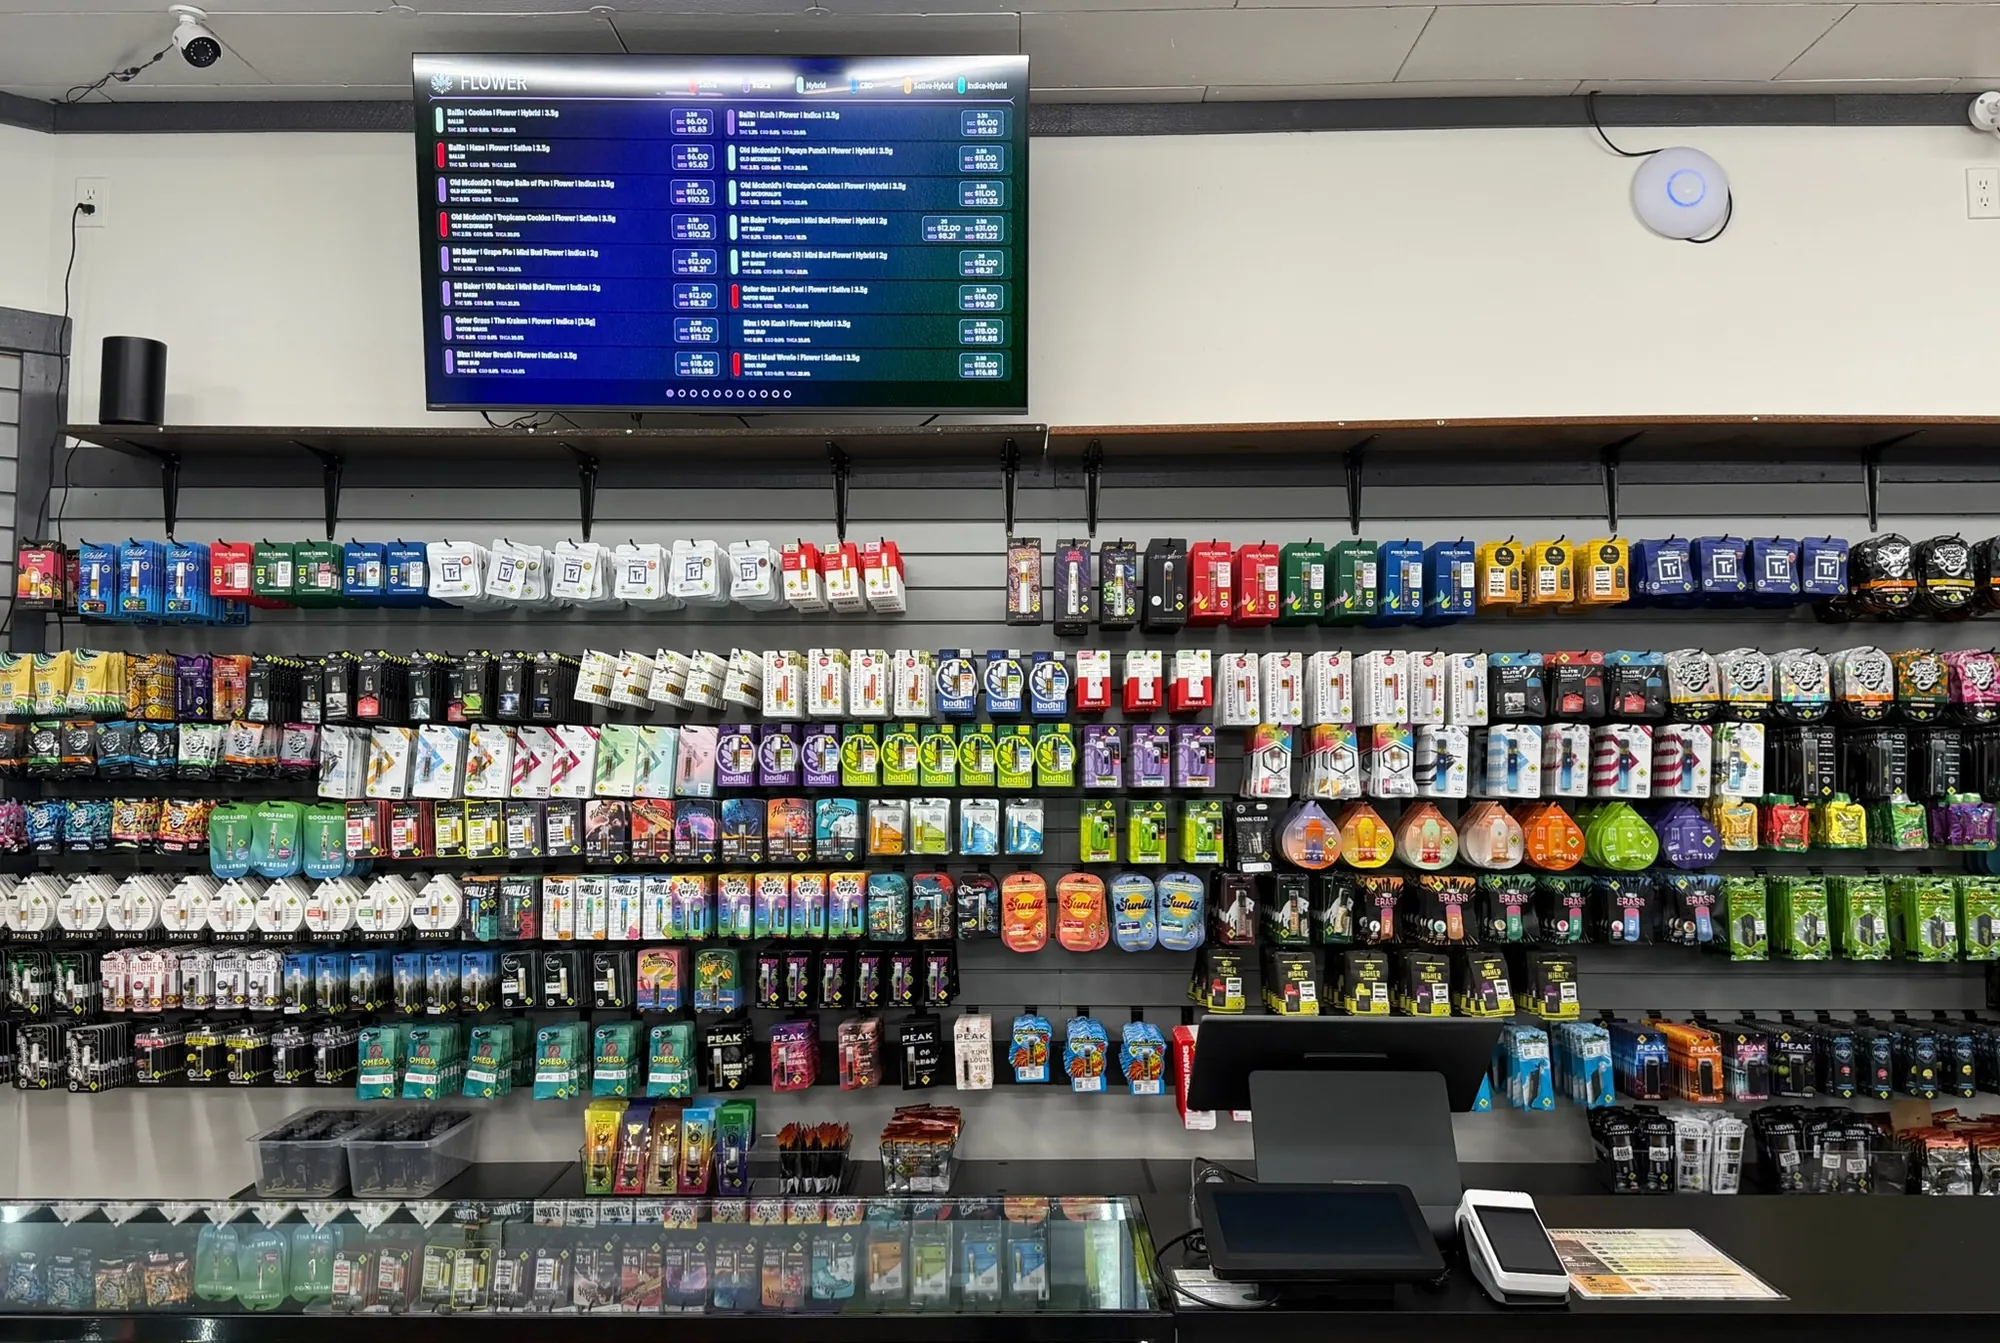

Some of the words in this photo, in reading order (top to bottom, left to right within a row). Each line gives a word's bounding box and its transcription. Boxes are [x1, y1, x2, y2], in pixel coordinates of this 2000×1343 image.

[461, 73, 527, 90] FLOWER
[806, 81, 826, 89] Hybrid
[913, 81, 953, 90] Sativa-Hybrid
[967, 81, 1007, 90] Indica-Hybrid
[521, 109, 541, 118] Hybrid
[545, 109, 559, 118] 3.5g
[826, 112, 839, 120] 3.5g
[536, 145, 550, 153] 3.5g
[856, 218, 875, 226] Hybrid
[879, 218, 887, 226] 2g
[590, 250, 598, 258] 2g
[1664, 562, 1677, 575] Tr
[1771, 561, 1786, 574] Tr
[1820, 561, 1835, 575] Tr
[722, 774, 746, 783] bodhi
[764, 774, 787, 783] bodhi
[807, 774, 831, 783] bodhi
[847, 774, 871, 783] bodhi
[888, 773, 911, 782] bodhi
[1002, 776, 1026, 784] bodhi
[1042, 774, 1066, 782] bodhi
[1293, 852, 1334, 861] GLOSTIX
[1346, 851, 1387, 860] GLOSTIX
[463, 884, 487, 896] THRILLS
[501, 885, 531, 897] THRILLS
[544, 884, 570, 896] THRILLS
[578, 884, 602, 896] THRILLS
[611, 884, 638, 896] THRILLS
[1007, 897, 1043, 911] Sunlit
[1116, 898, 1152, 912] Sunlit
[1163, 894, 1198, 910] Sunlit
[12, 932, 38, 940] SPOIL'D
[101, 961, 126, 971] HIGHER
[131, 961, 164, 971] HIGHER
[214, 959, 247, 970] HIGHER
[247, 959, 277, 970] HIGHER
[707, 1033, 742, 1044] PEAK
[773, 1034, 805, 1042] PEAK
[842, 1033, 872, 1042] PEAK
[902, 1033, 933, 1042] PEAK
[956, 1032, 986, 1040] PEAK
[1637, 1044, 1666, 1052] PEAK
[1690, 1046, 1719, 1054] PEAK
[1737, 1044, 1766, 1052] PEAK
[1780, 1043, 1812, 1052] PEAK
[362, 1058, 391, 1066] OMEGA
[409, 1057, 436, 1065] OMEGA
[472, 1056, 496, 1065] OMEGA
[538, 1057, 567, 1066] OMEGA
[596, 1056, 625, 1064] OMEGA
[652, 1056, 680, 1064] OMEGA
